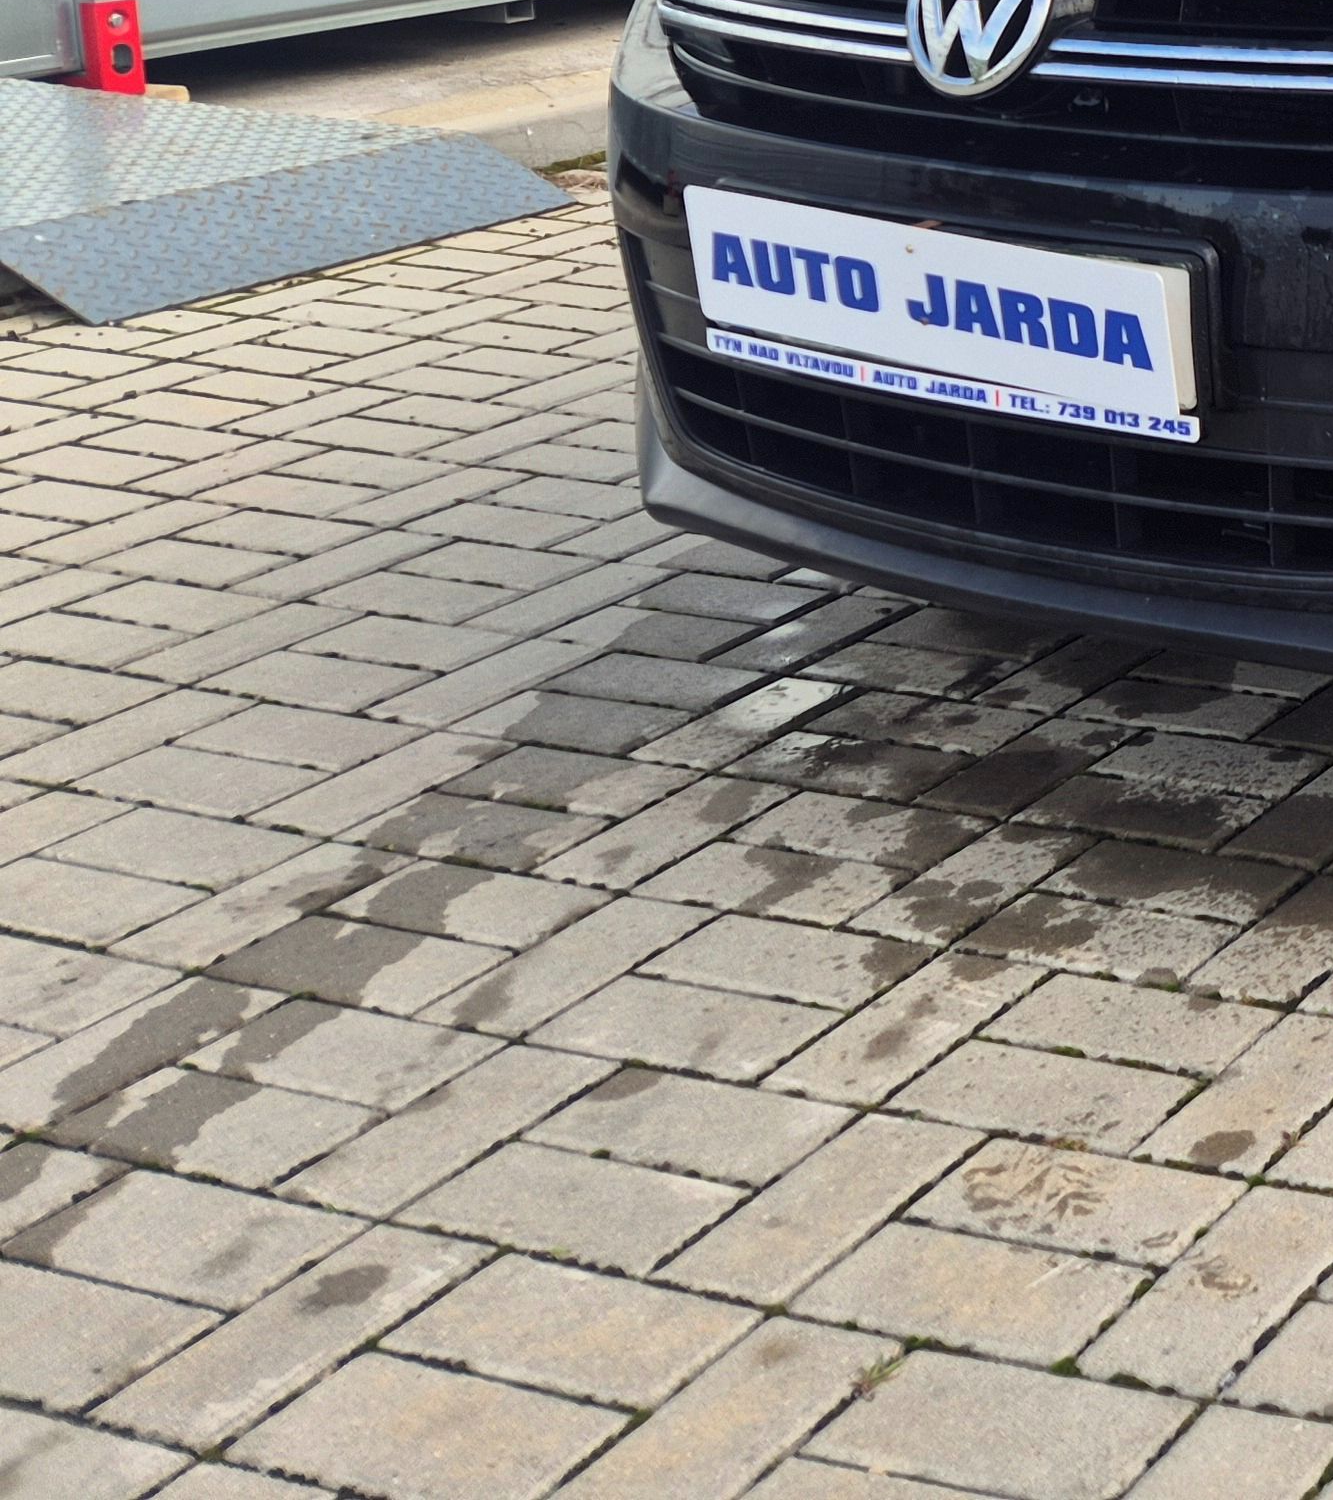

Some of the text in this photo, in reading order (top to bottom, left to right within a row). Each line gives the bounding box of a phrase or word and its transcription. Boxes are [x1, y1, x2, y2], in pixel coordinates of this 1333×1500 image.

[711, 231, 1154, 372] AUTO JARDA
[748, 342, 779, 361] NAD
[785, 351, 854, 378] VLTAVOU
[873, 369, 917, 390] AUTO
[925, 380, 988, 404] JARDA
[1009, 392, 1050, 414] TEL.:
[1058, 401, 1096, 421] 739
[1104, 408, 1140, 428] 013
[1149, 415, 1191, 436] 245
